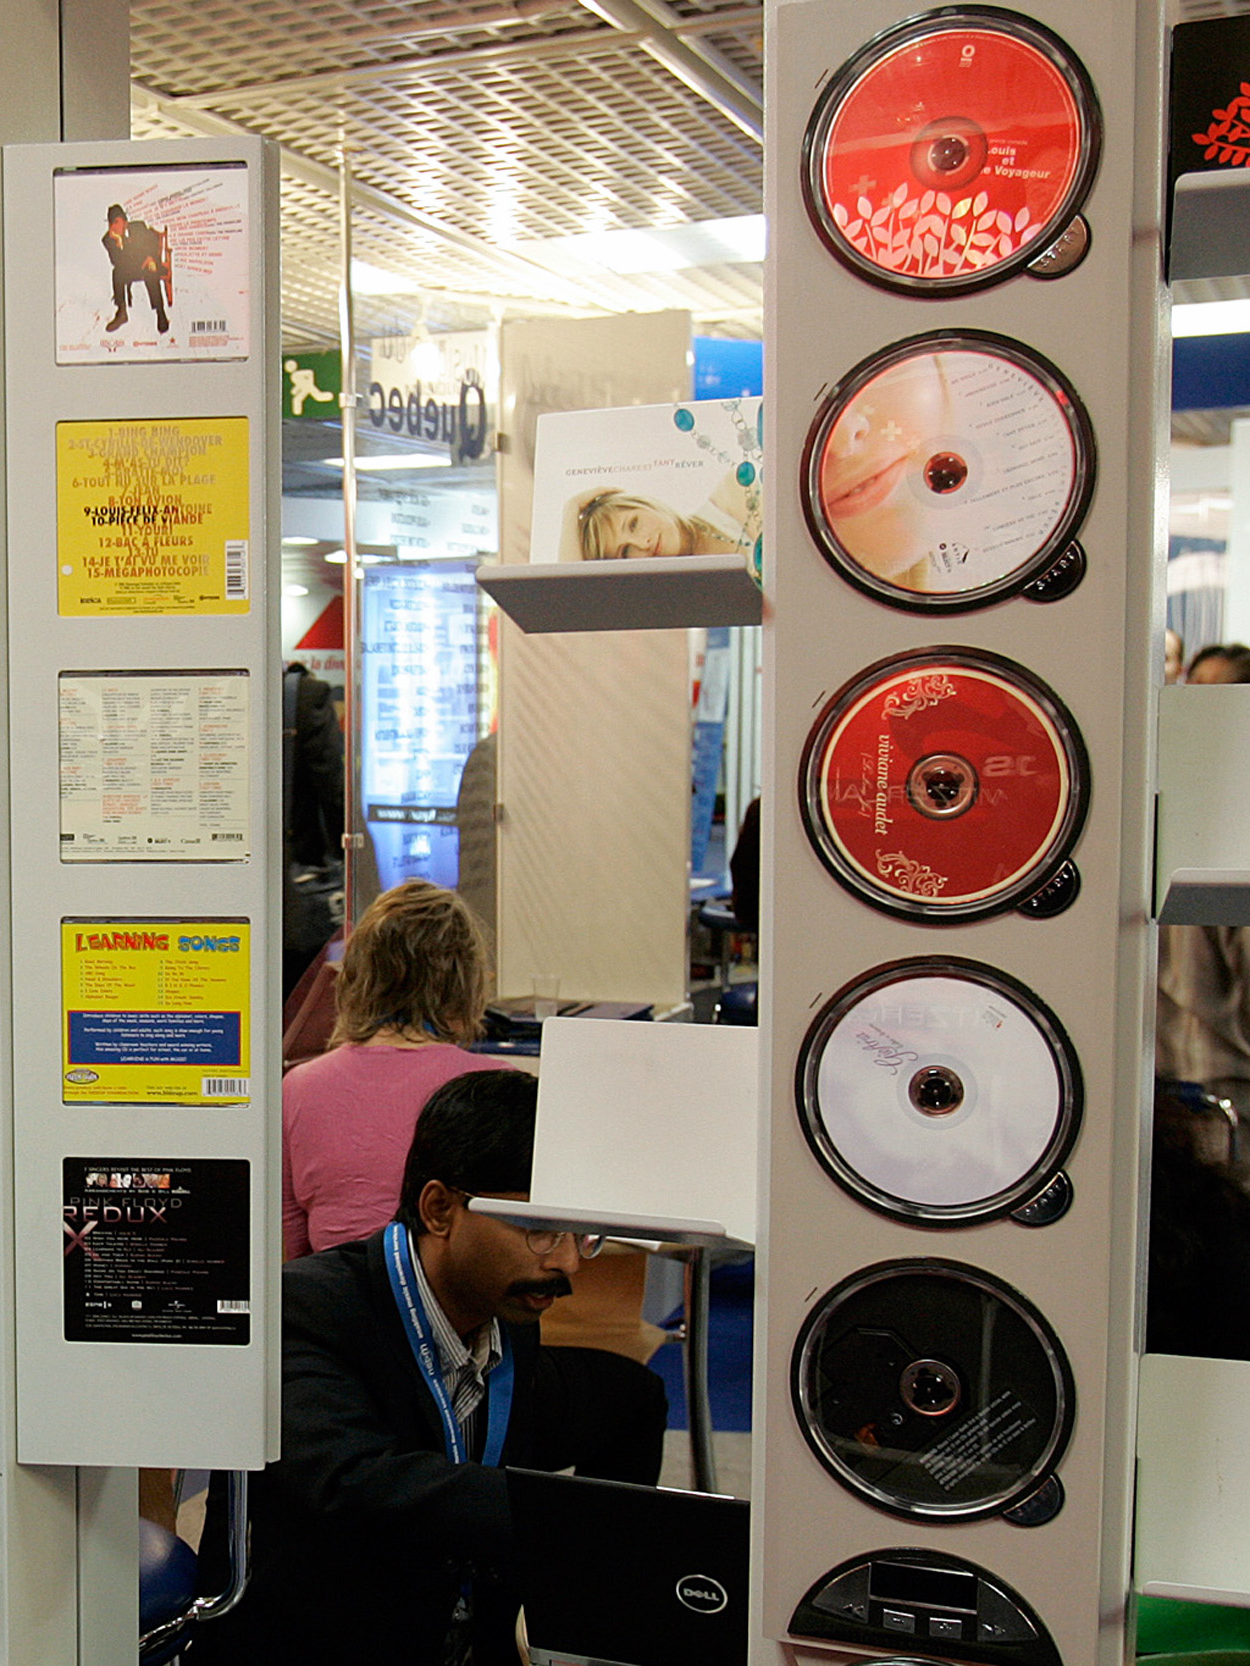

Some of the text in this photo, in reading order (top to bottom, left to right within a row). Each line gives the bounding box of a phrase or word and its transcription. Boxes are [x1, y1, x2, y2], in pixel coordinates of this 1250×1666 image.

[988, 146, 1016, 155] ouis
[1002, 156, 1015, 165] et
[995, 165, 1051, 179] Voyageur
[160, 513, 204, 525] VIANDE
[154, 535, 194, 547] FLEURS
[161, 555, 178, 565] ME
[182, 554, 210, 565] VOIR
[874, 734, 894, 836] viviane audet
[75, 931, 241, 953] LEARNING SONGS
[70, 1197, 182, 1209] PINK FLOYD
[63, 1205, 167, 1223] REDUX
[418, 1343, 435, 1376] net-m
[682, 1586, 721, 1602] DELL
